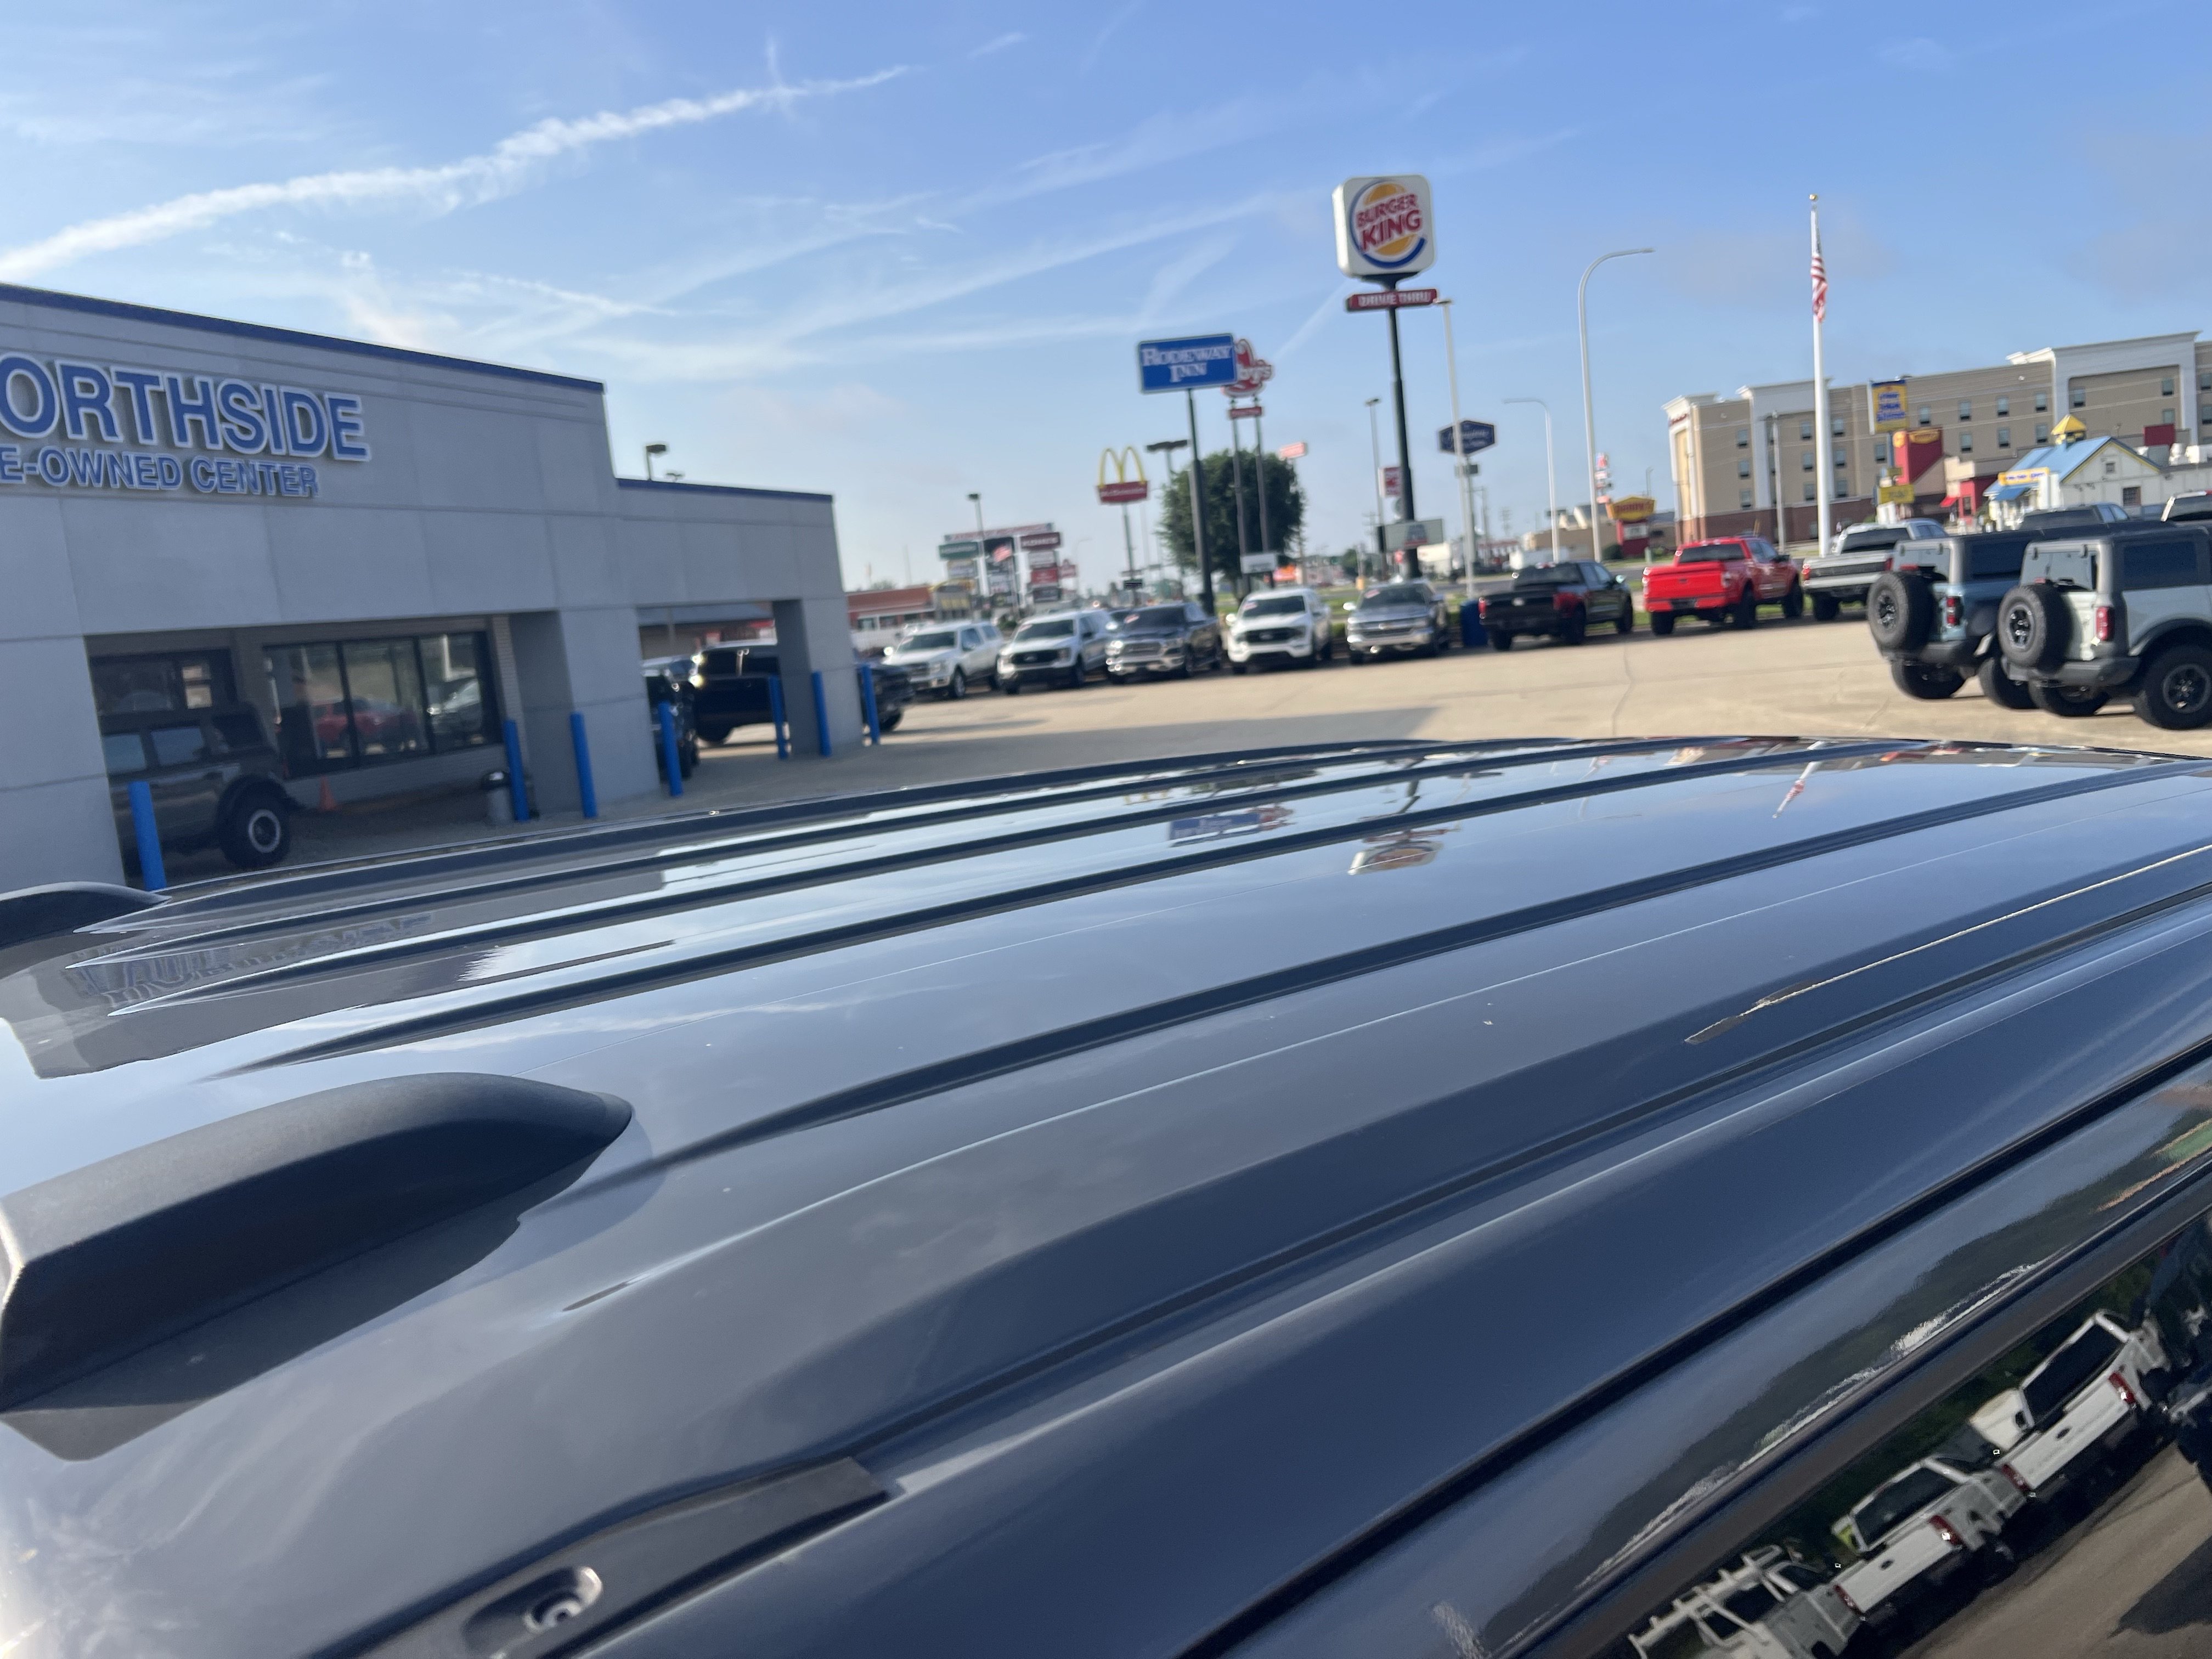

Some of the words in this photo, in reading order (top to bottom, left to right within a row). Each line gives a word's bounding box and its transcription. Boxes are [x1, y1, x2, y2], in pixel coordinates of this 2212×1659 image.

[1357, 194, 1417, 227] BURGER
[1362, 209, 1421, 251] KING
[1142, 346, 1232, 366] RODEWAY
[0, 353, 371, 461] ORTHSIDE
[0, 444, 183, 492] E-OWNED
[190, 456, 319, 497] CENTER
